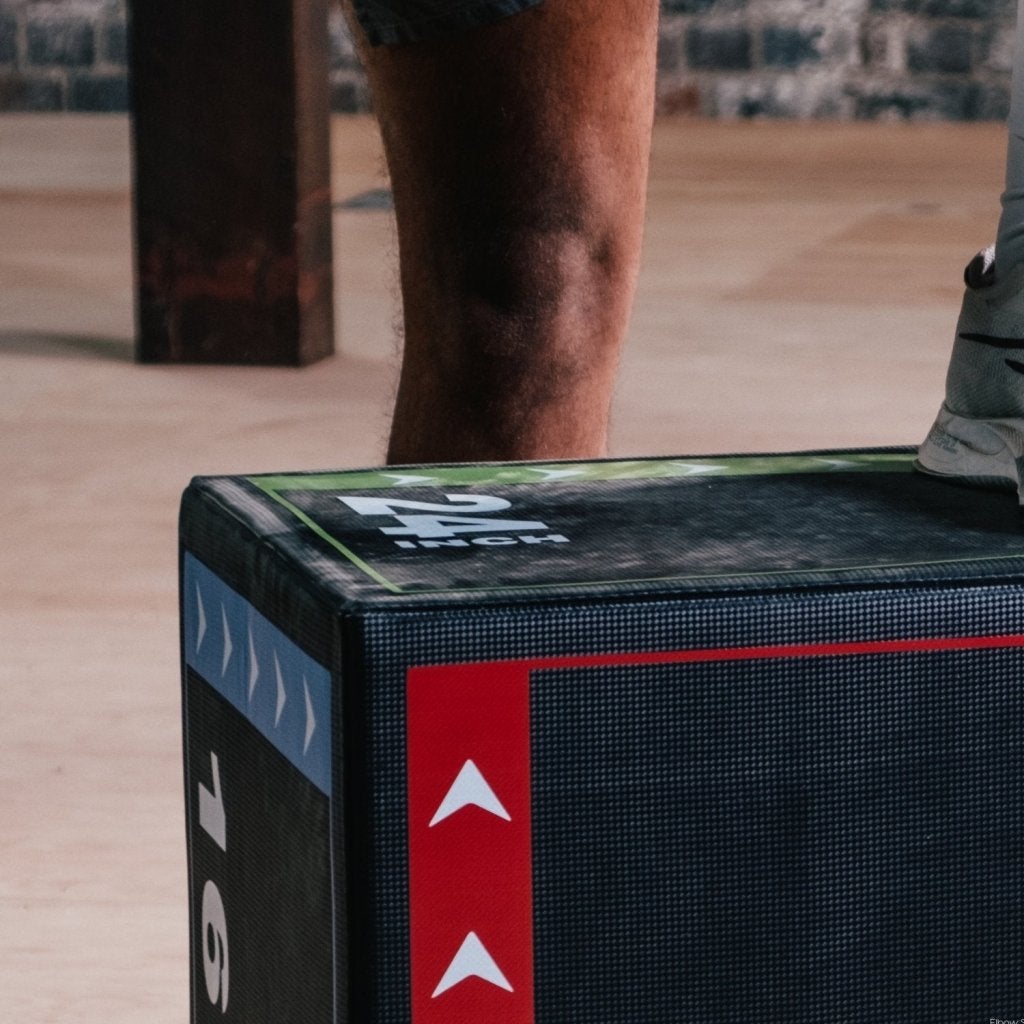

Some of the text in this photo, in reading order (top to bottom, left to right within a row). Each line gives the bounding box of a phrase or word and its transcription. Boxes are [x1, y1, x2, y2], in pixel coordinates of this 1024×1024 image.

[337, 493, 550, 537] 24
[394, 533, 570, 549] INCH
[198, 751, 230, 1014] 16
